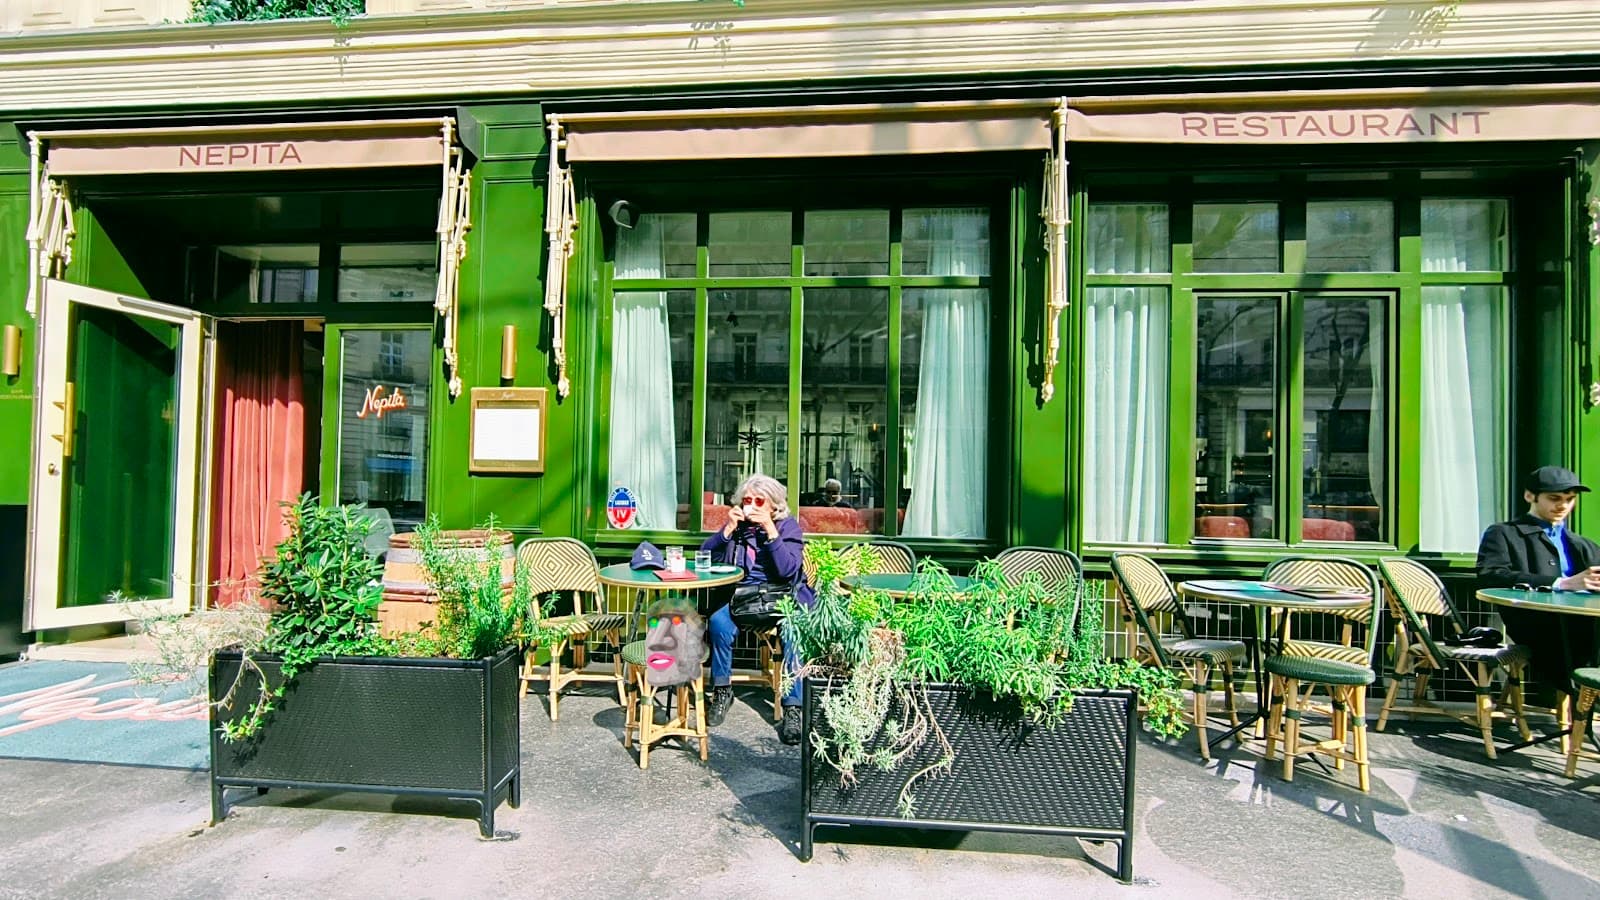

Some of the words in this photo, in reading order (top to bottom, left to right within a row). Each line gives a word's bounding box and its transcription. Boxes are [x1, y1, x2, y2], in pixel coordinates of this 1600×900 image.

[1181, 111, 1490, 137] RESTAURANT
[179, 143, 302, 166] NEPITA
[356, 385, 405, 418] Nepita
